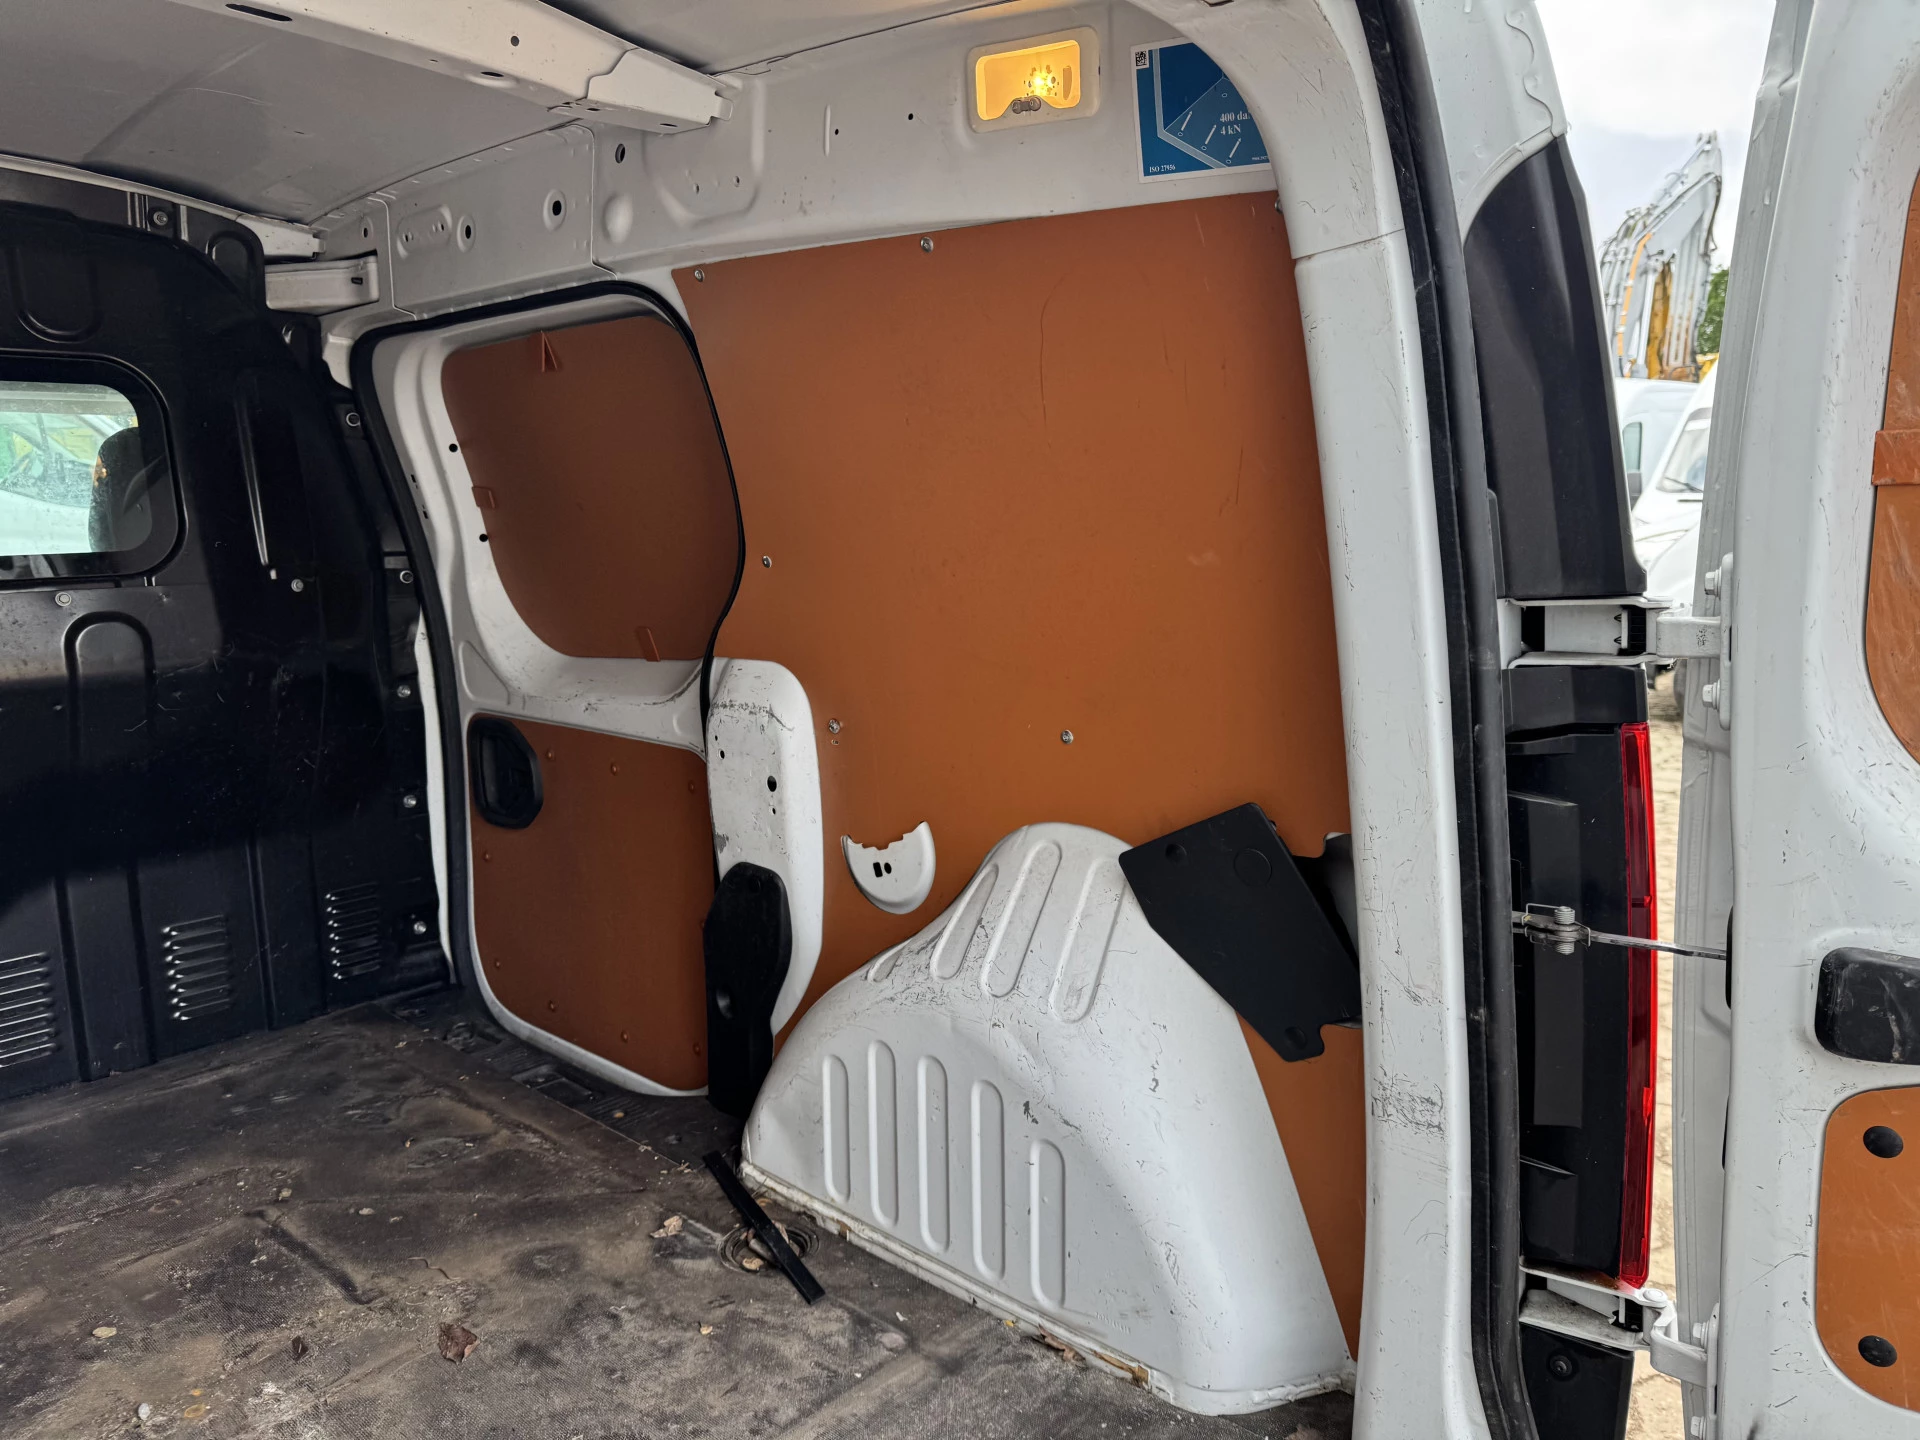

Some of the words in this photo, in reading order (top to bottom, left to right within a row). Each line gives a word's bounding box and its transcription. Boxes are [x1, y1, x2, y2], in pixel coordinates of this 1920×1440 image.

[1219, 112, 1235, 123] 400
[1220, 126, 1226, 136] 4
[1228, 123, 1241, 135] kN
[1149, 165, 1160, 173] ISO
[1160, 164, 1176, 172] 27956
